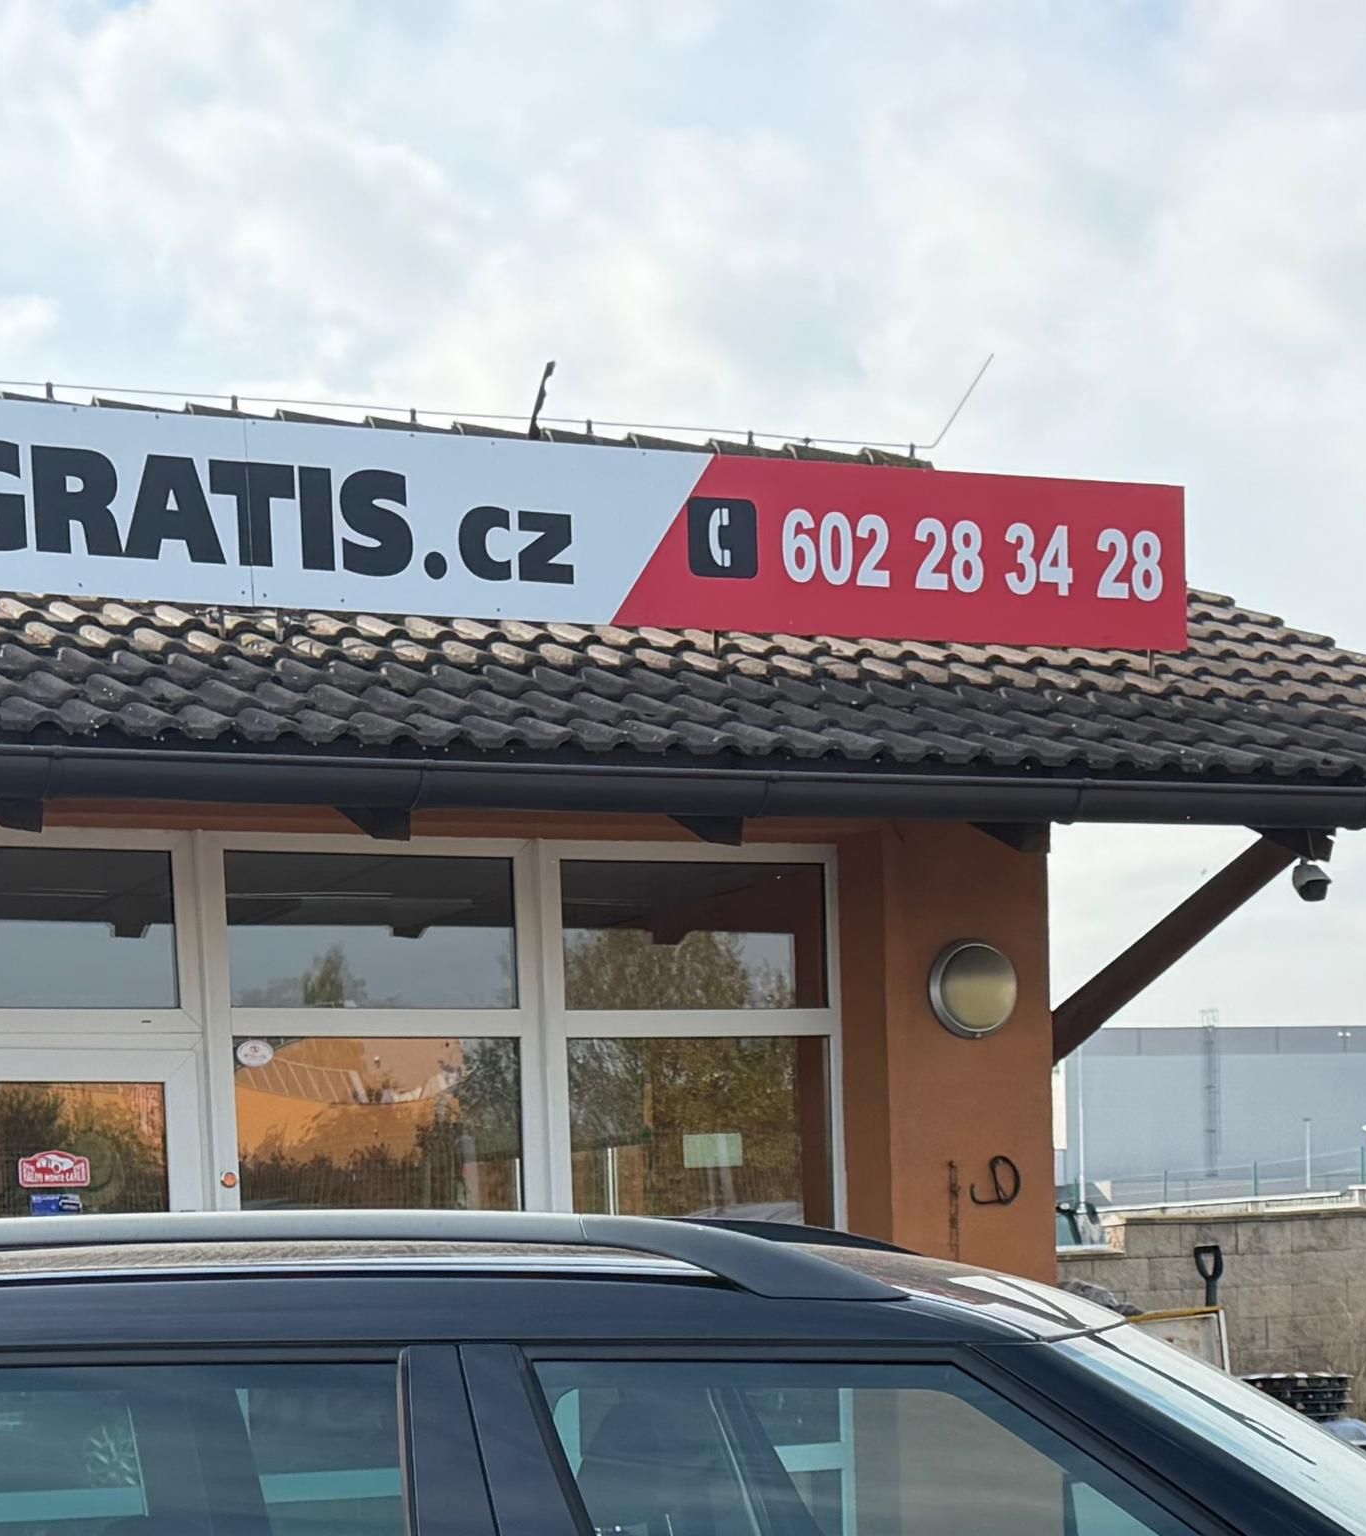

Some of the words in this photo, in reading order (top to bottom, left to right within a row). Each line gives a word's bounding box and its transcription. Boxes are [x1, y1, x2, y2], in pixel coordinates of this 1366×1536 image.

[781, 508, 891, 588] 602
[914, 517, 985, 594] 28
[1003, 522, 1074, 597] 34
[1096, 528, 1164, 602] 28
